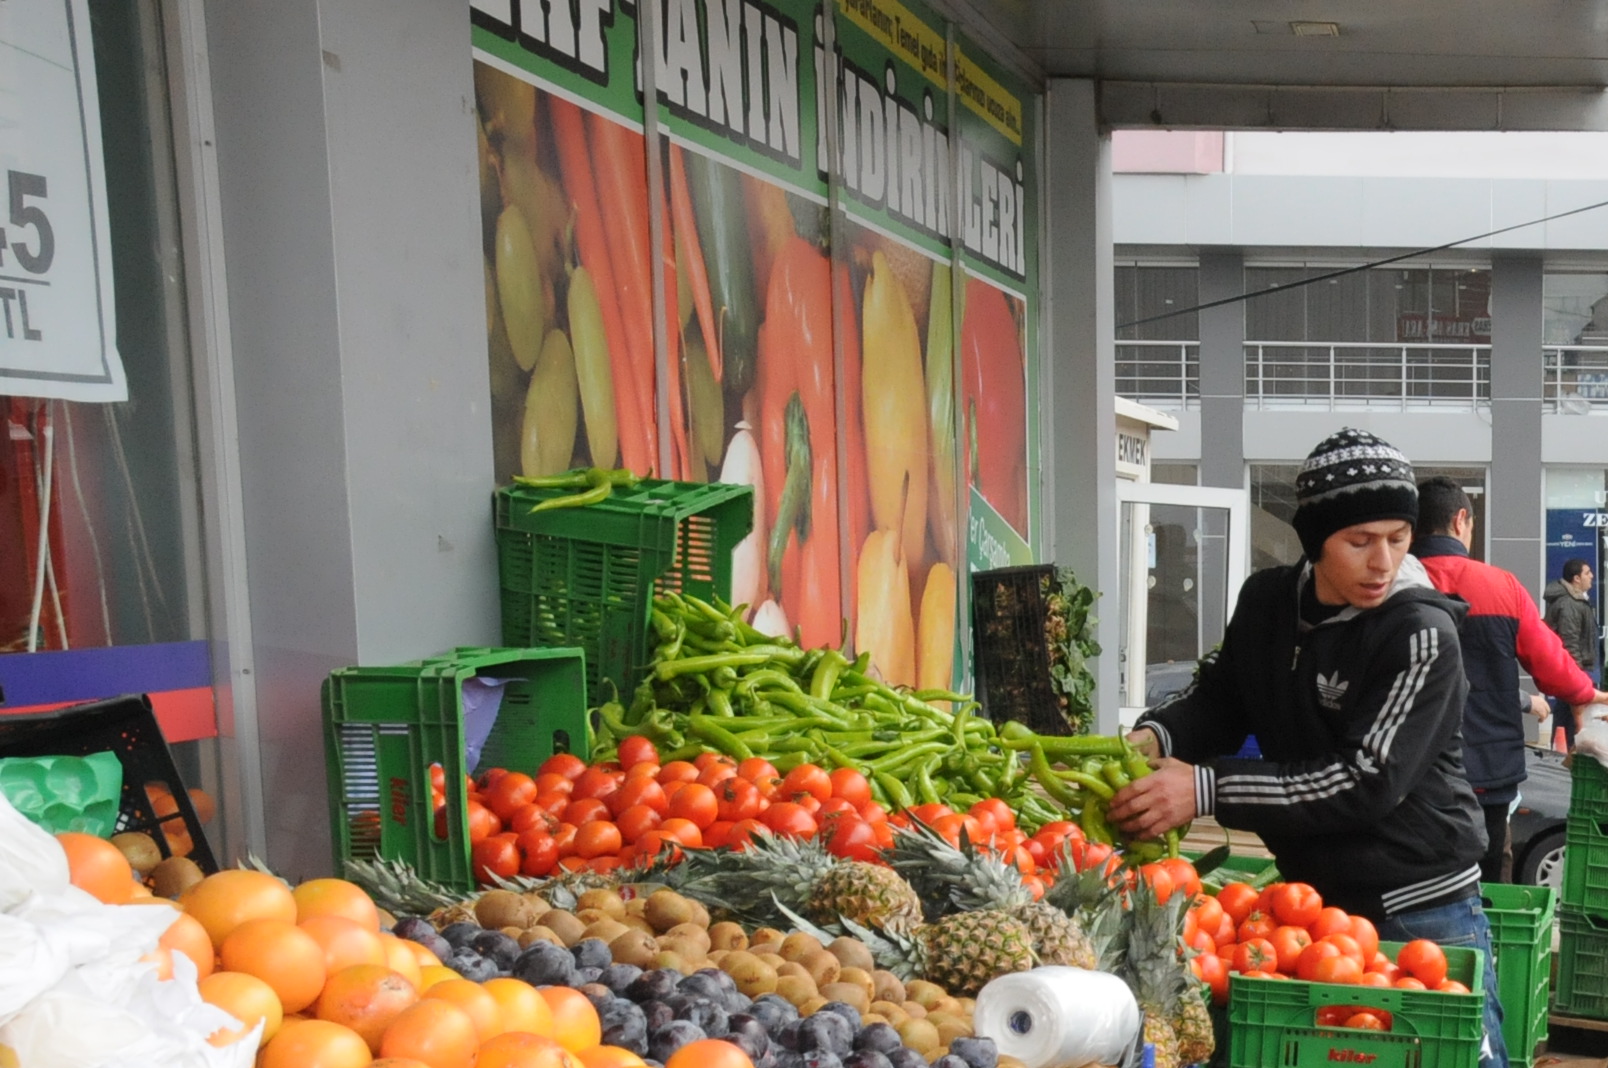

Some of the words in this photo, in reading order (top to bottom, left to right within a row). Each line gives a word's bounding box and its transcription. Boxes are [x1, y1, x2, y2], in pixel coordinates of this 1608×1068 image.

[815, 13, 1025, 276] İNDİRİMLERİ
[1119, 433, 1146, 467] EKMEK
[390, 776, 410, 828] kiler
[1328, 1048, 1377, 1064] kiler
